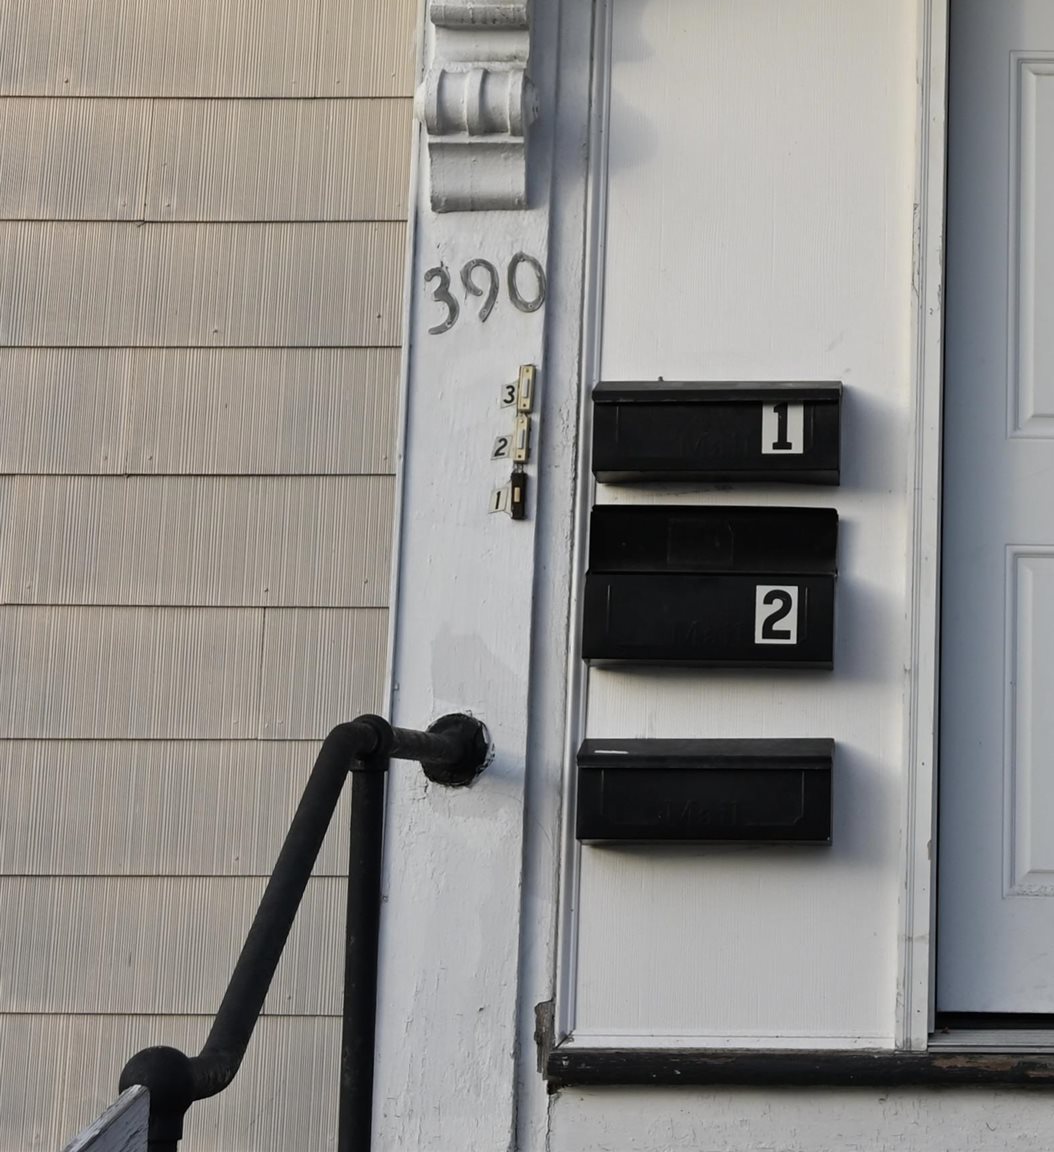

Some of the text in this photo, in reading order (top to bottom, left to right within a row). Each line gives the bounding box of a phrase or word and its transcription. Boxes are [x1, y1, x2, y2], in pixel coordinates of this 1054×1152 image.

[424, 251, 547, 335] 390
[503, 384, 516, 404] 3
[772, 402, 793, 450] 1
[494, 437, 508, 457] 2
[494, 491, 502, 510] 1
[761, 589, 792, 640] 2
